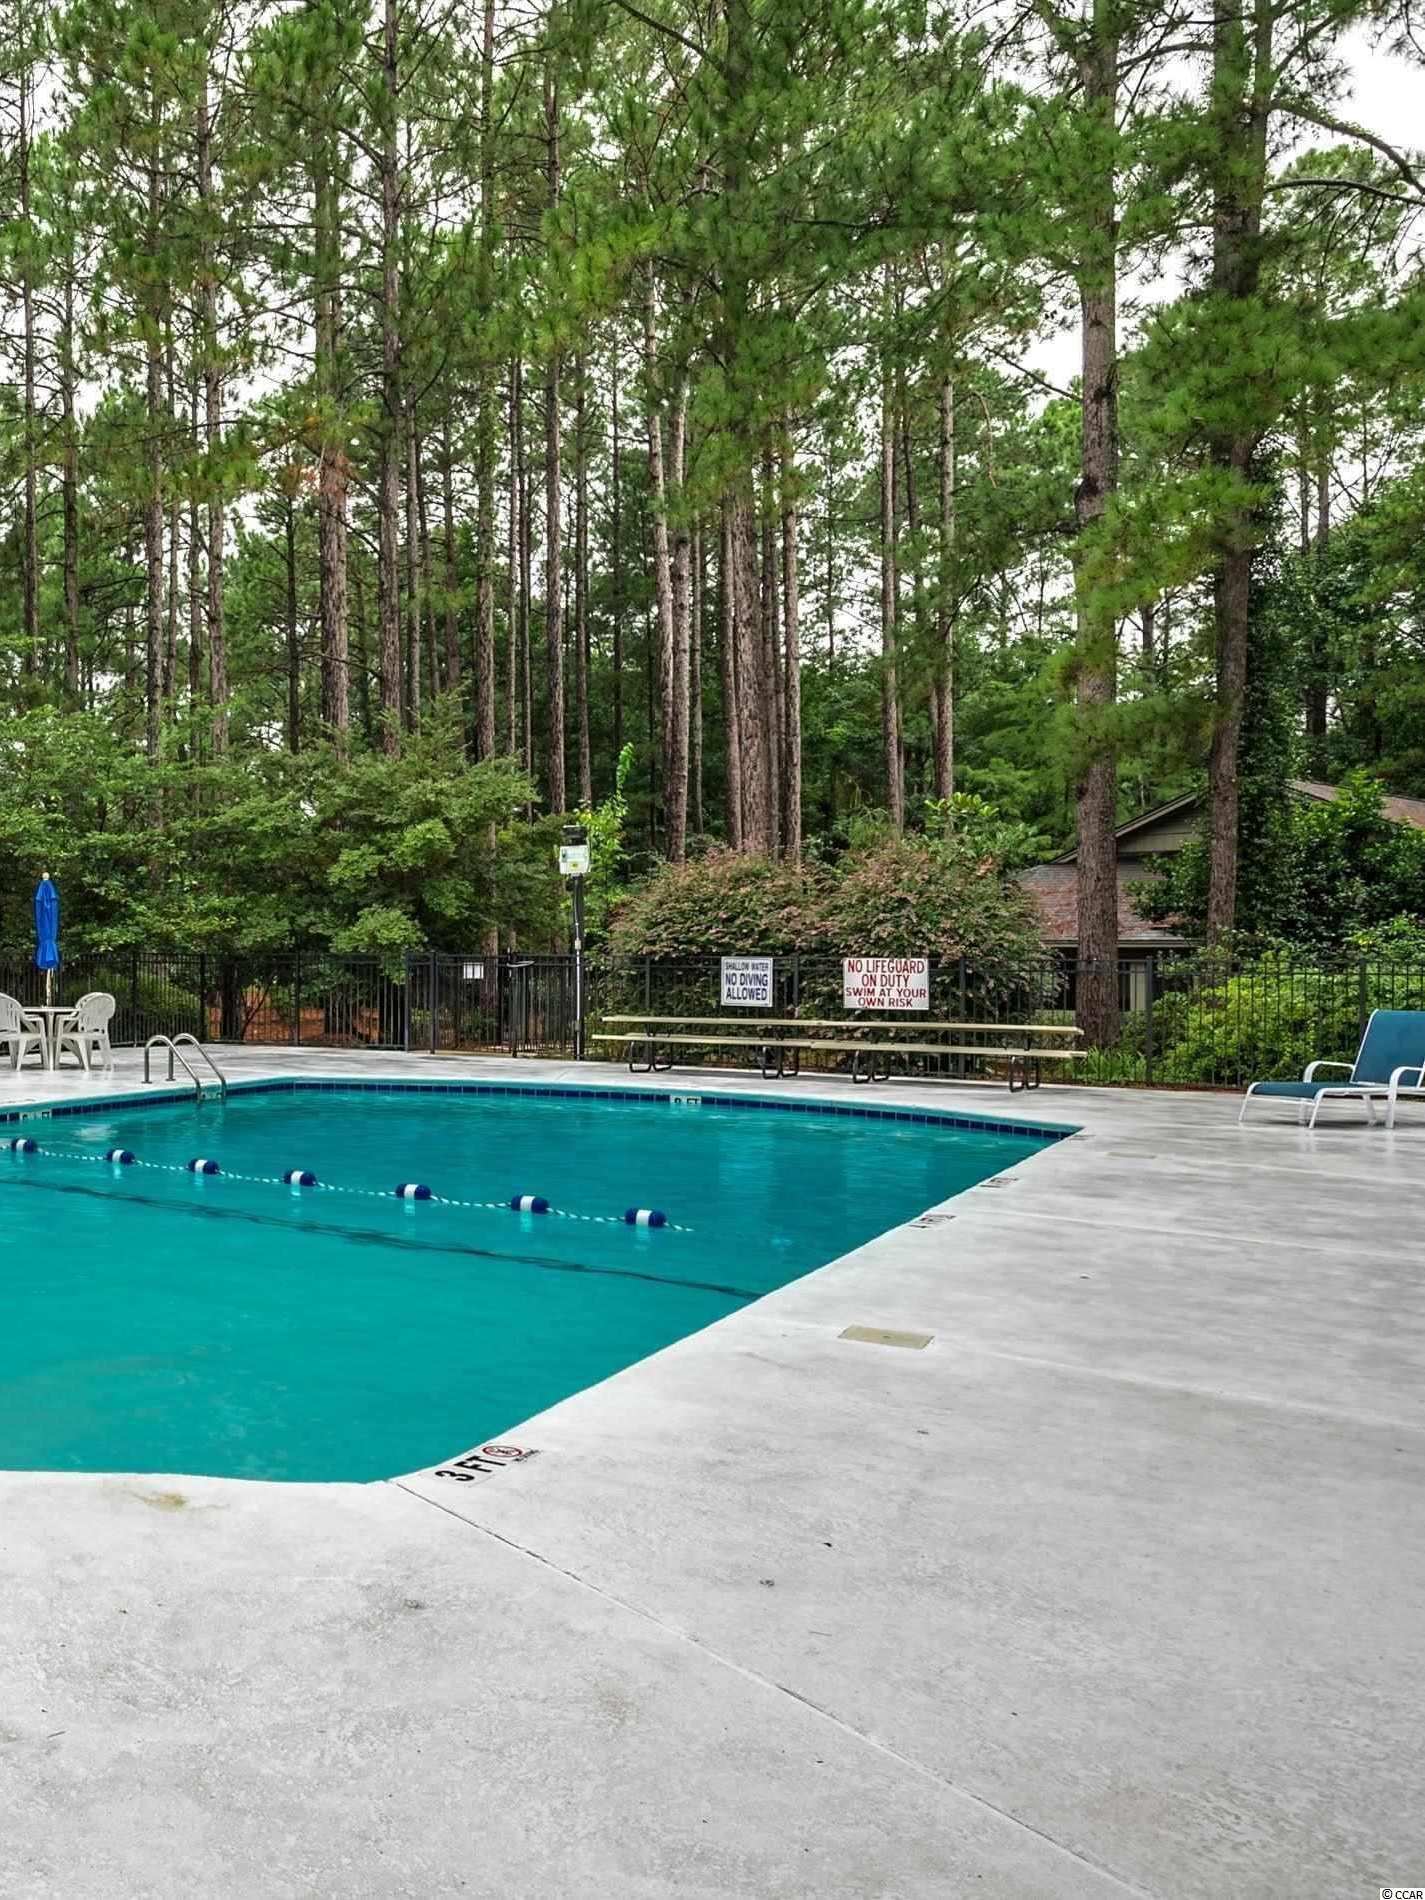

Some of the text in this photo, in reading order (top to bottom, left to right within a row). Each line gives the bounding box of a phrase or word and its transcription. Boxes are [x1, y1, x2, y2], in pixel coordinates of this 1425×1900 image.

[847, 959, 925, 974] NO LIFEGUARD
[725, 972, 768, 987] NO DIVING
[861, 974, 910, 988] ON DUTY
[726, 986, 768, 1001] ALLOWED
[846, 987, 927, 999] SWIM AT YOUR
[857, 997, 913, 1008] OWN RISK
[453, 1455, 507, 1473] FT
[435, 1470, 475, 1482] 3
